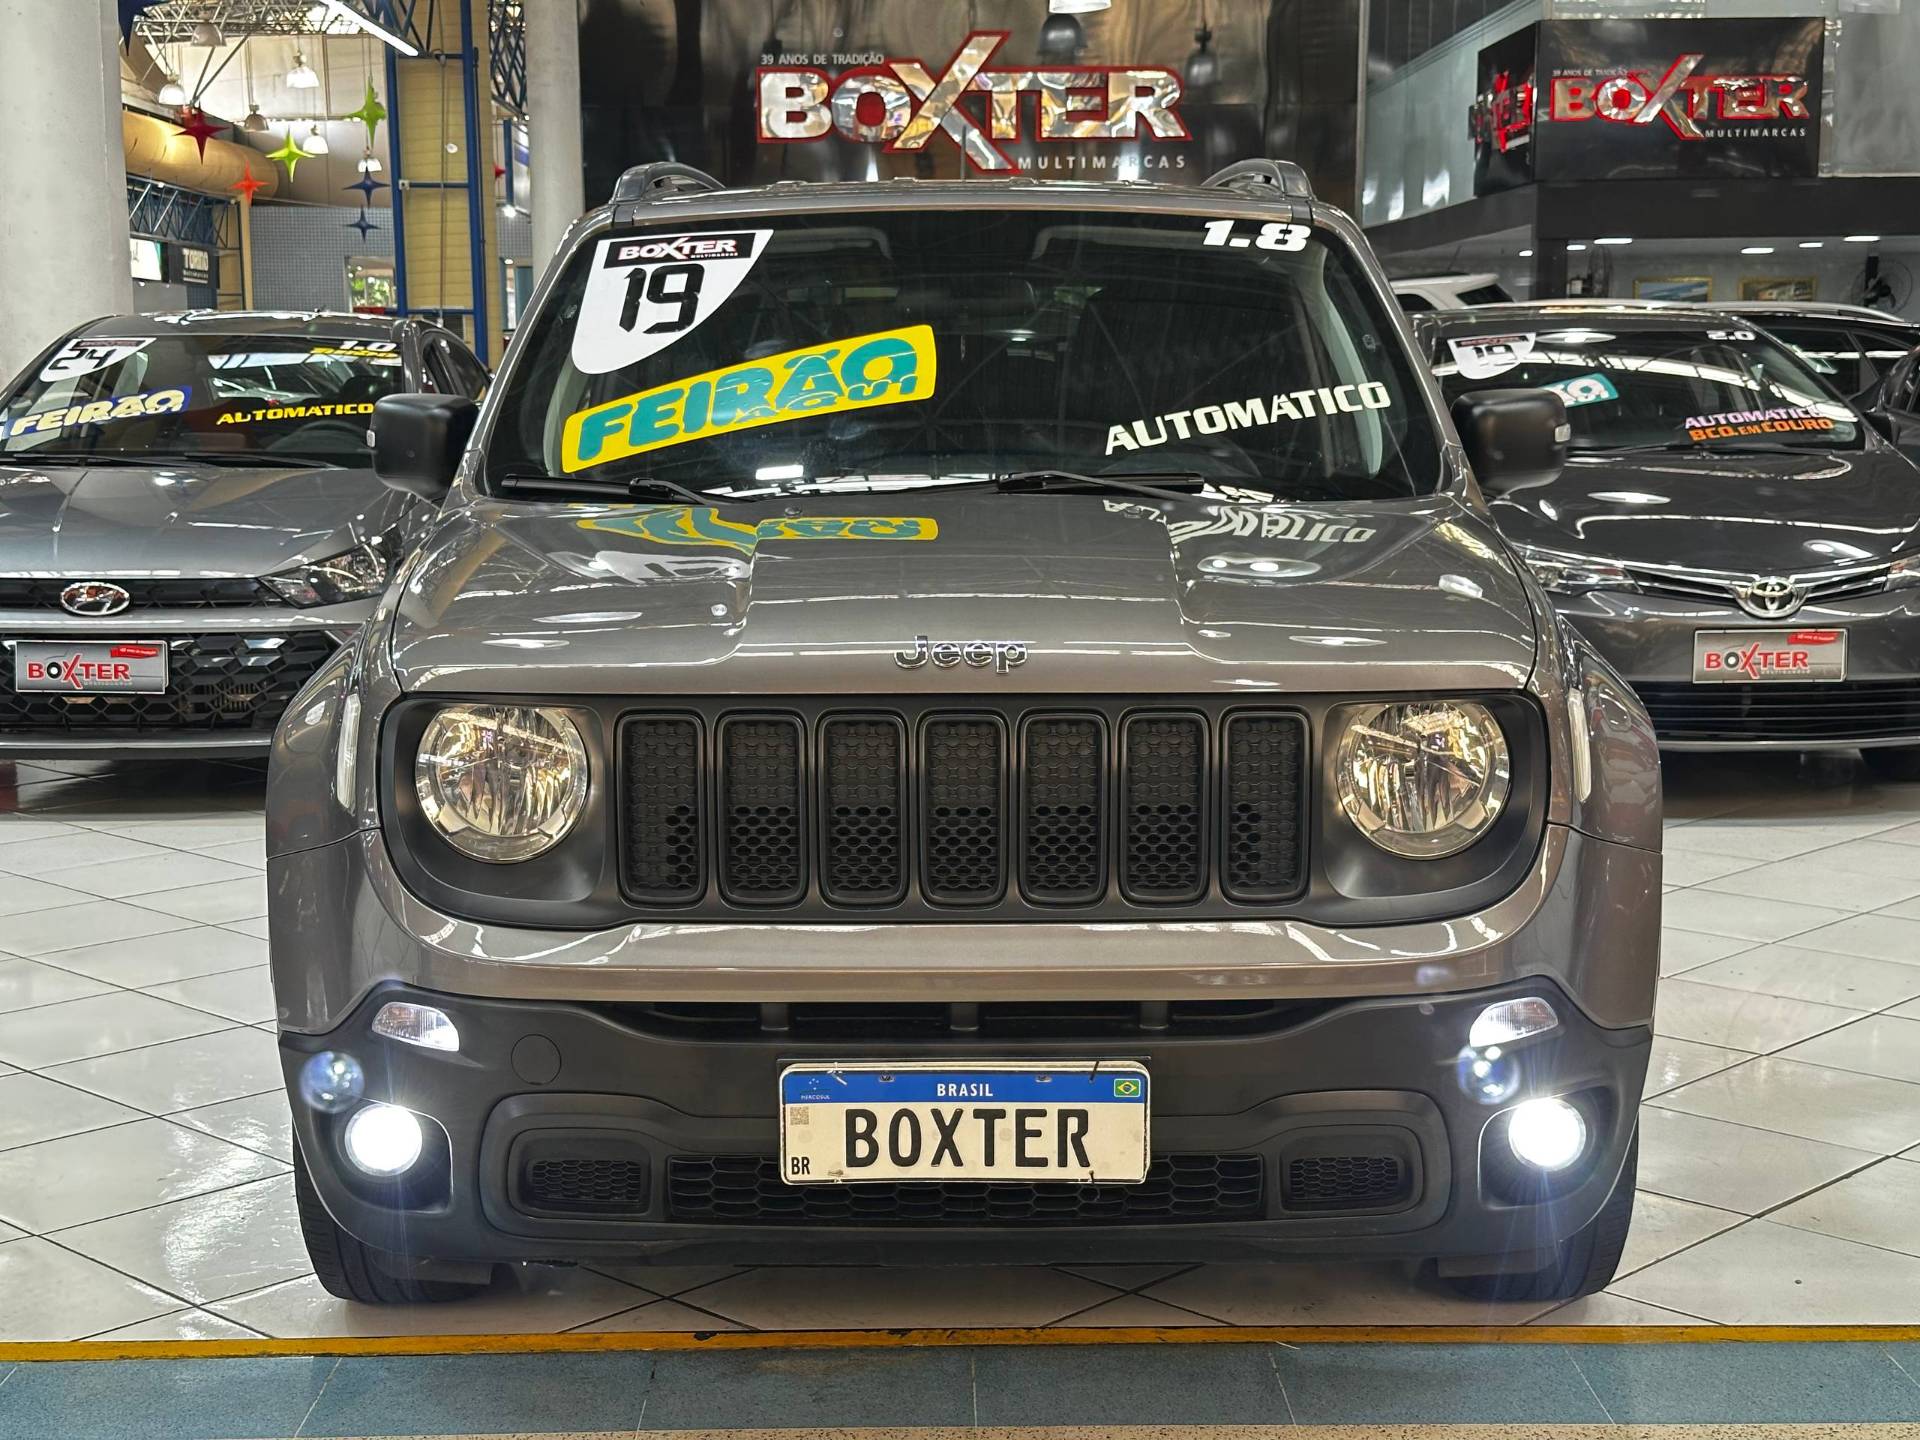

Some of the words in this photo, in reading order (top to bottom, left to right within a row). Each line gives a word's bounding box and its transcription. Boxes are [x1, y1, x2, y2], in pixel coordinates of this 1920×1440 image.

[761, 54, 774, 65] 39
[779, 54, 808, 65] ANOS
[813, 54, 827, 65] DE
[832, 51, 884, 66] TRADIÇÃO
[757, 29, 1193, 174] BOXTER
[1550, 53, 1809, 140] BOXTER
[1705, 127, 1806, 137] MULTIMARCAS
[1017, 154, 1187, 170] MULTIMARCAS
[617, 236, 738, 261] BOXTER
[1203, 220, 1311, 251] 1.8
[619, 263, 705, 334] 19
[339, 340, 397, 352] 1.0
[1706, 329, 1756, 341] 2.0
[48, 348, 117, 371] 24
[10, 389, 185, 436] FEIRÃO
[578, 337, 917, 461] FEIRÃO
[1738, 424, 1761, 436] EM
[1761, 417, 1834, 435] COURO
[894, 635, 1028, 674] Jeep
[1704, 642, 1810, 680] BOXTER
[27, 653, 132, 689] BOXTER
[936, 1083, 993, 1097] BRASIL
[845, 1108, 1091, 1168] BOXTER
[791, 1156, 811, 1176] BR
